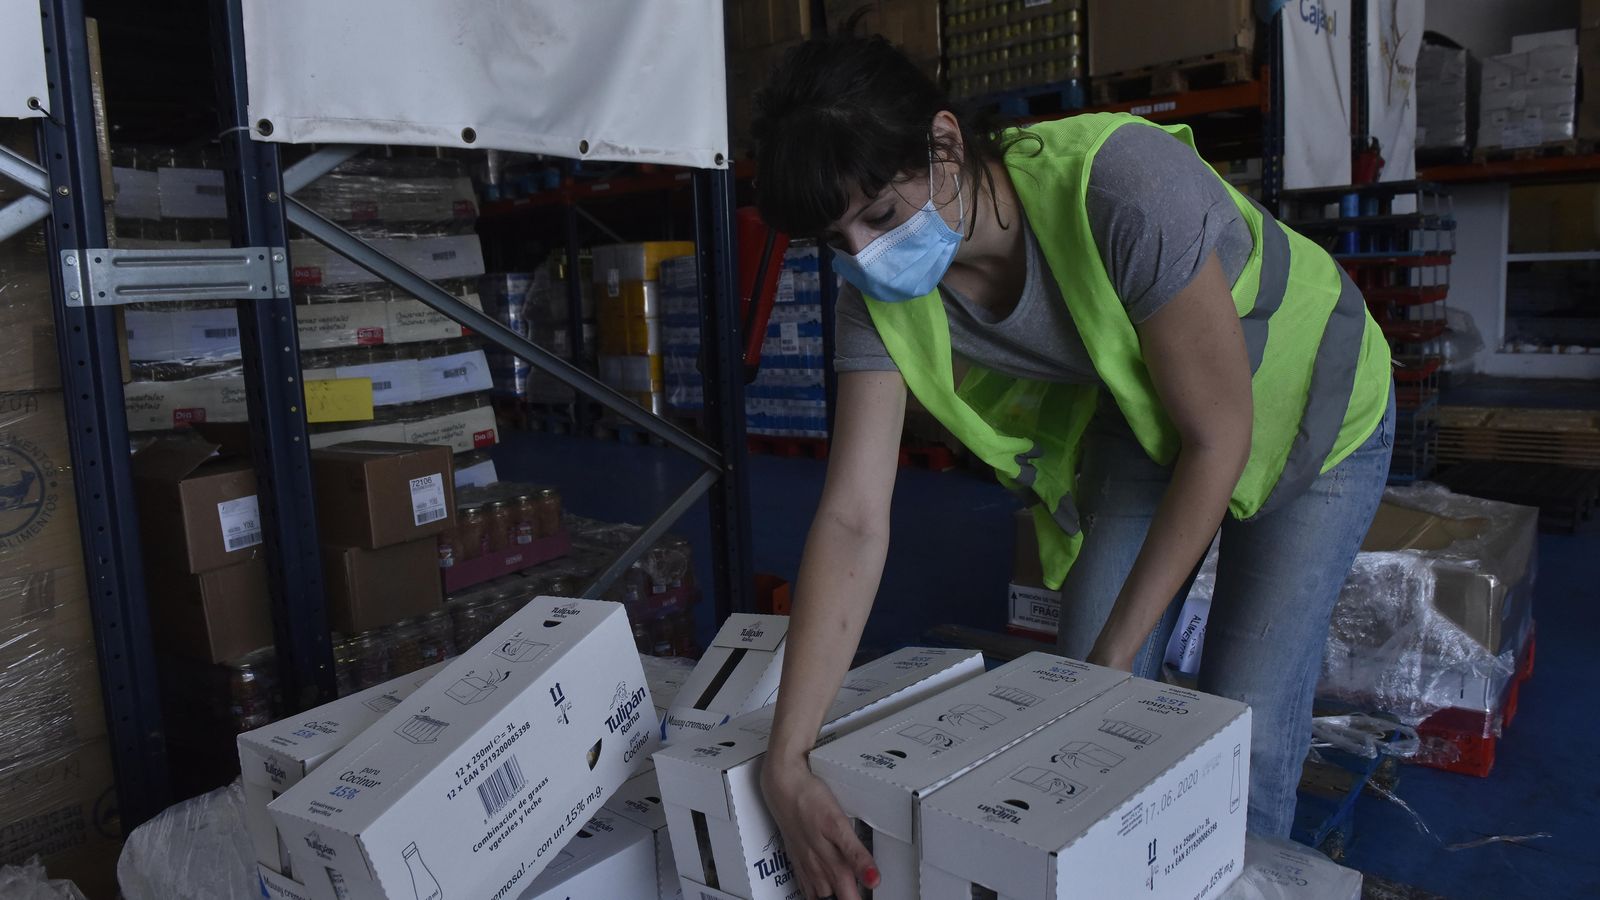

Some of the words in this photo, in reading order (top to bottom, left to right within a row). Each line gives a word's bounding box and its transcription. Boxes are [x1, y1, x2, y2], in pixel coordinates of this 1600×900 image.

[1032, 604, 1059, 618] FRÁG
[740, 628, 764, 639] Tulipán
[604, 686, 647, 734] Tulipán
[1138, 699, 1190, 716] Cocinar
[1146, 706, 1172, 716] para
[1156, 695, 1189, 708] 15%
[304, 721, 338, 736] Cocinar
[620, 711, 641, 736] Rama
[623, 731, 651, 764] Cocinar
[455, 767, 465, 779] 12
[466, 762, 472, 771] x
[471, 741, 495, 763] 250ml
[263, 761, 287, 780] Tulipán
[339, 770, 382, 789] Cocinar
[359, 766, 382, 777] para
[328, 784, 361, 801] 15%
[446, 789, 457, 801] 12
[457, 784, 464, 792] x
[463, 769, 480, 787] EAN
[1144, 769, 1200, 825] 17.06.2020
[472, 806, 517, 854] Combinación
[517, 798, 528, 810] de
[527, 776, 550, 803] grasas
[977, 803, 1022, 825] Tulipán
[488, 819, 520, 853] vgetales
[518, 814, 525, 825] y
[523, 797, 543, 818] leche
[304, 835, 337, 858] Tulipán
[489, 862, 526, 900] emosa!
[536, 839, 553, 859] con
[553, 824, 566, 840] un
[566, 798, 586, 828] 15%
[586, 784, 604, 806] m.g.
[1175, 851, 1185, 867] EAN
[774, 870, 795, 888] Ram
